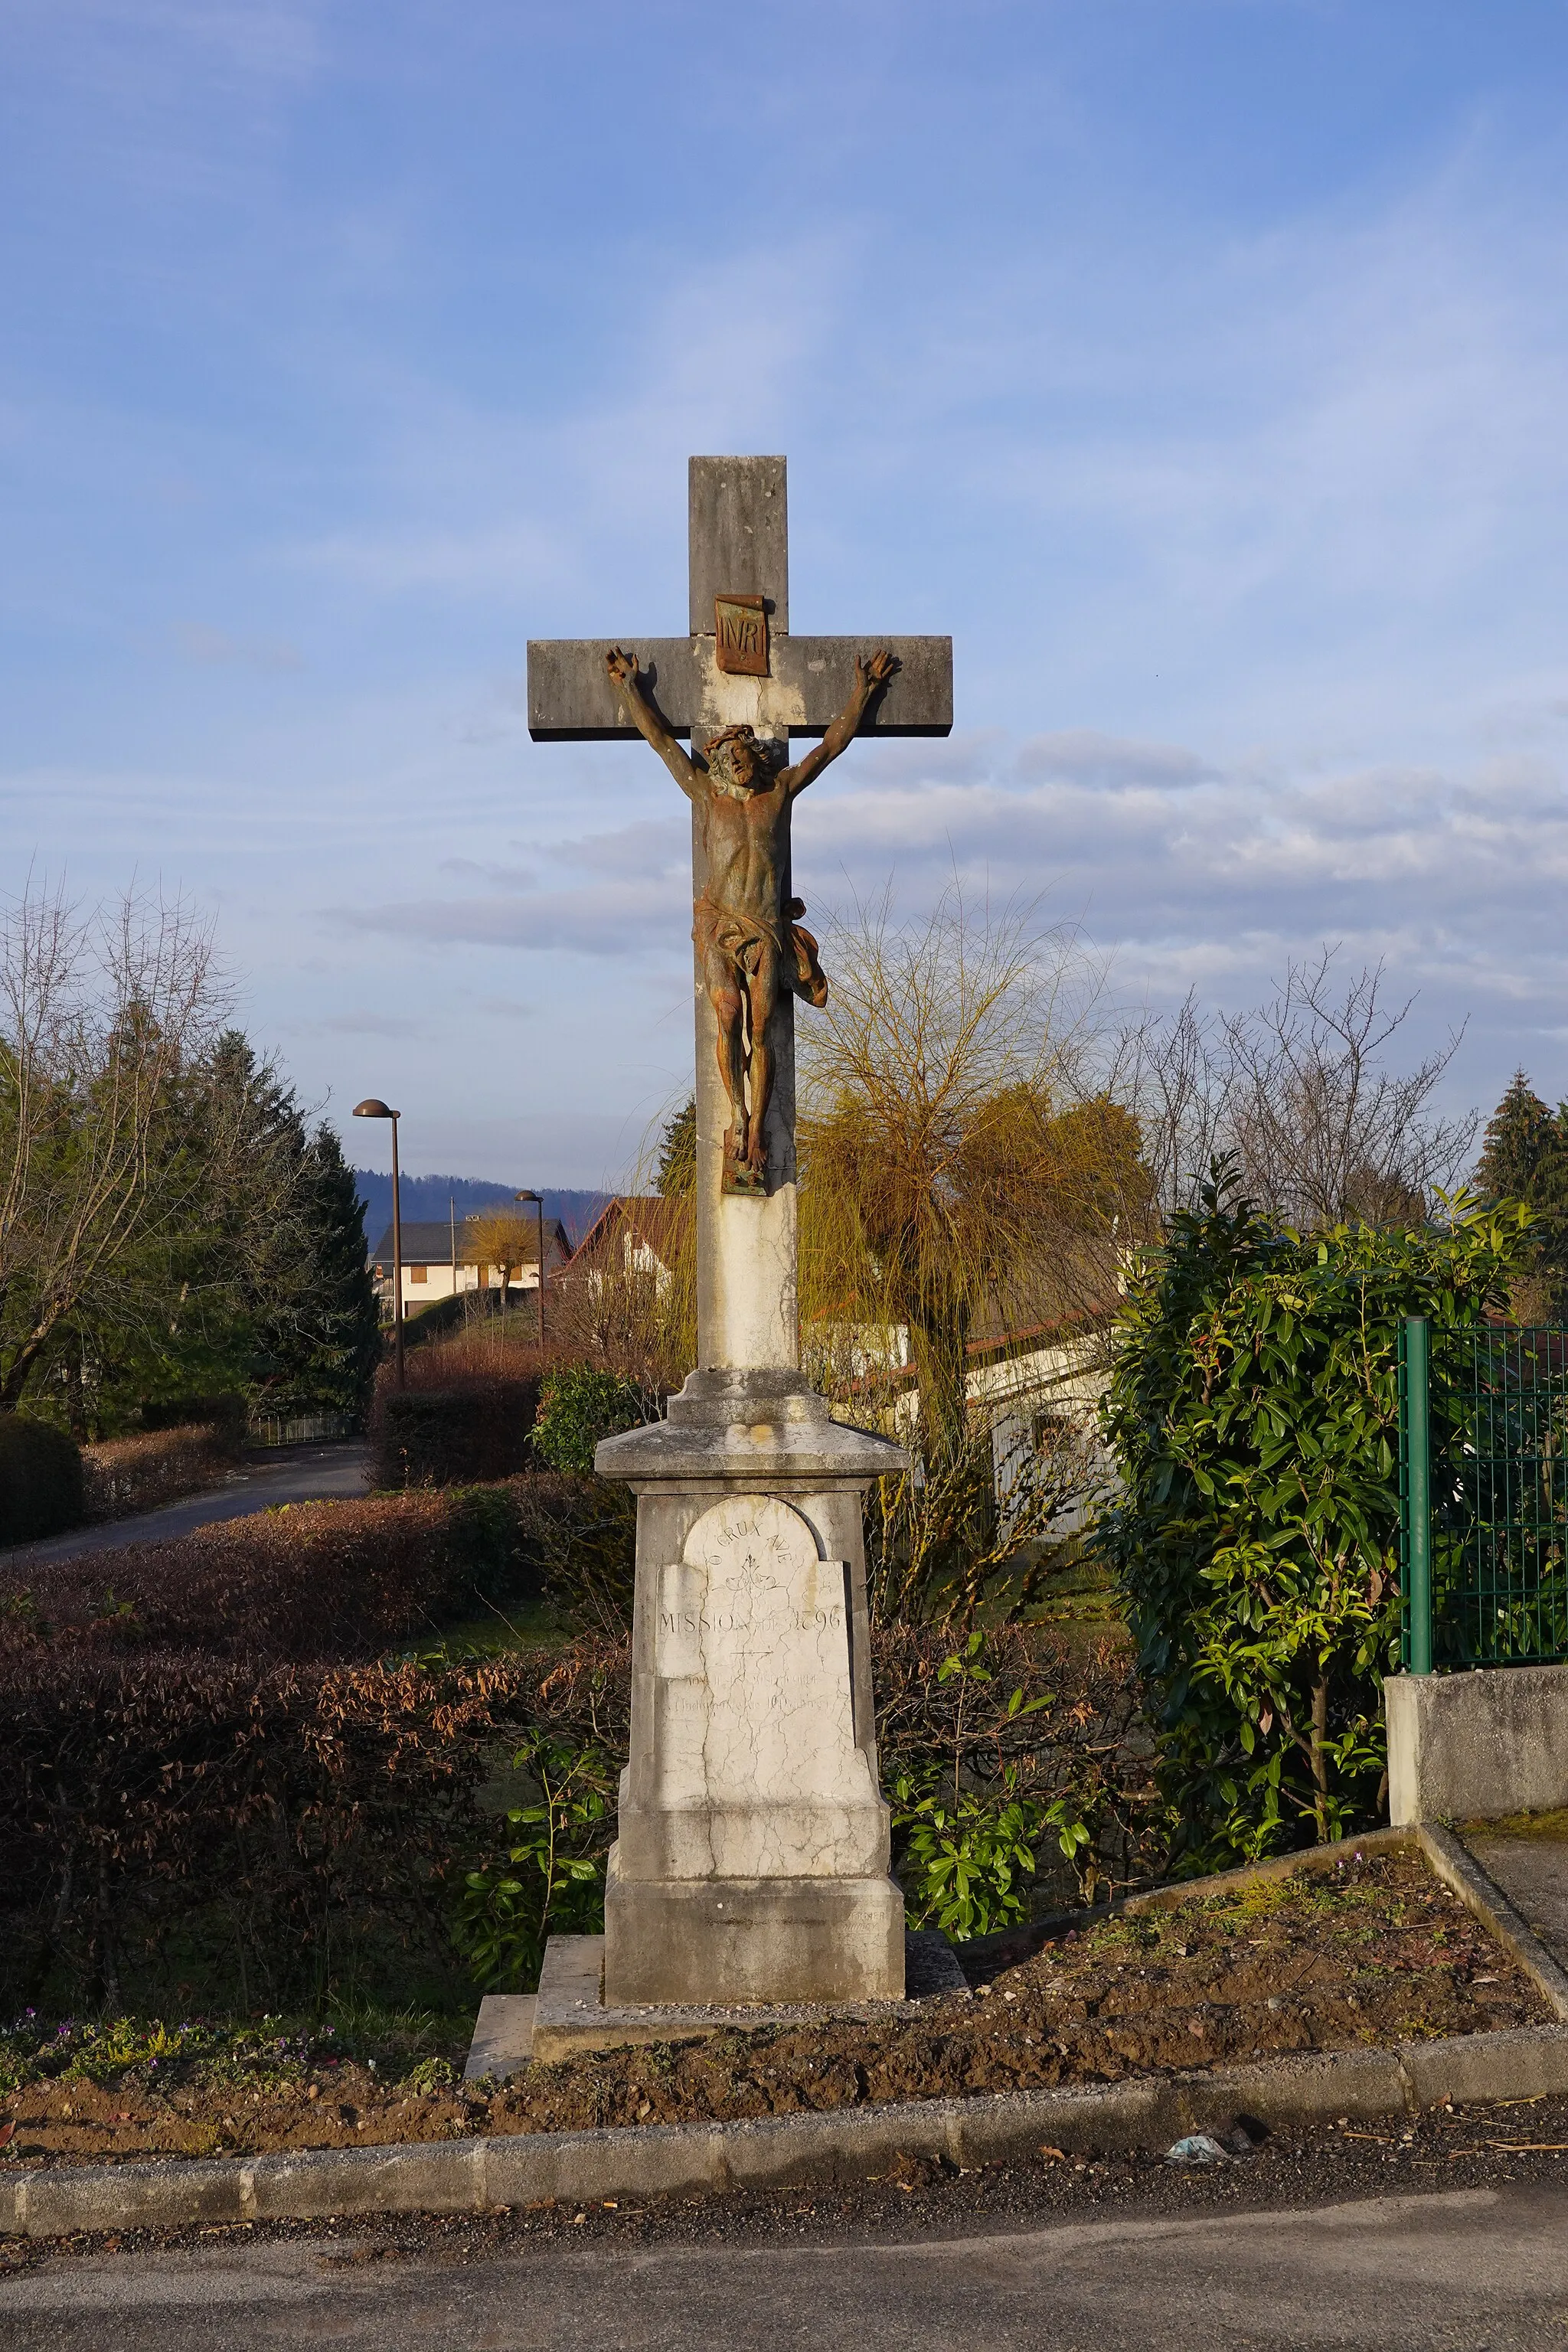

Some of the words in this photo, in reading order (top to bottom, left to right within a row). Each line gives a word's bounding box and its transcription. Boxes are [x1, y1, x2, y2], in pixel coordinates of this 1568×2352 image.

[720, 616, 765, 657] INRI
[708, 1555, 722, 1565] O
[717, 1521, 763, 1547] CRUX
[766, 1534, 792, 1563] AVE
[659, 1612, 750, 1632] MISSION
